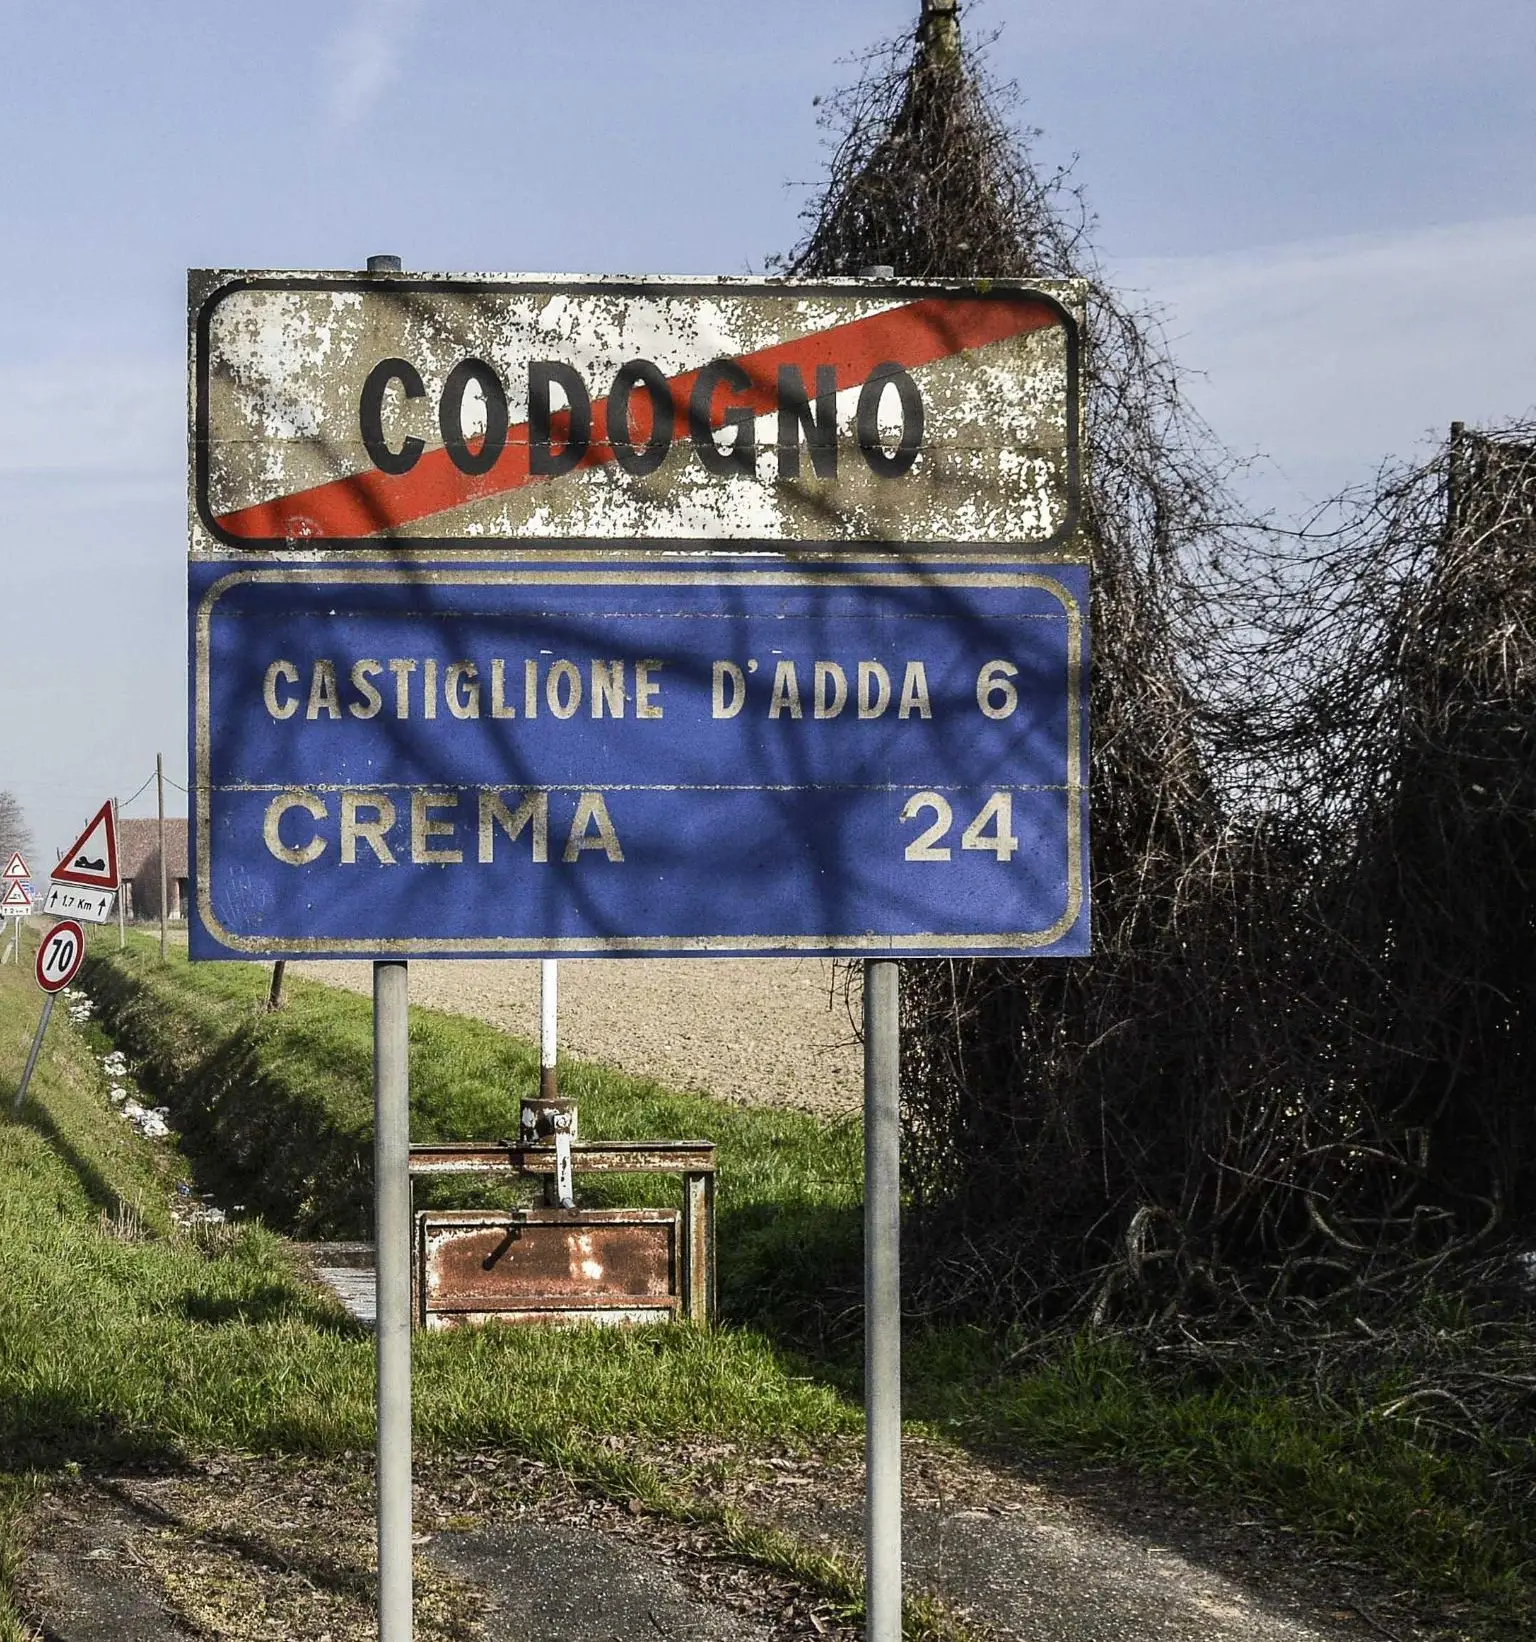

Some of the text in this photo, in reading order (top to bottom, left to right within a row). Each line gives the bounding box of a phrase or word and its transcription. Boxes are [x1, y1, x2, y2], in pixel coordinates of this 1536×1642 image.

[358, 356, 925, 480] CODOGNO
[263, 656, 1020, 722] CASTIGLIONE D'ADDA 6
[263, 791, 624, 866] CREMA
[902, 790, 1020, 862] 24
[77, 899, 92, 910] Km
[46, 938, 73, 972] 70
